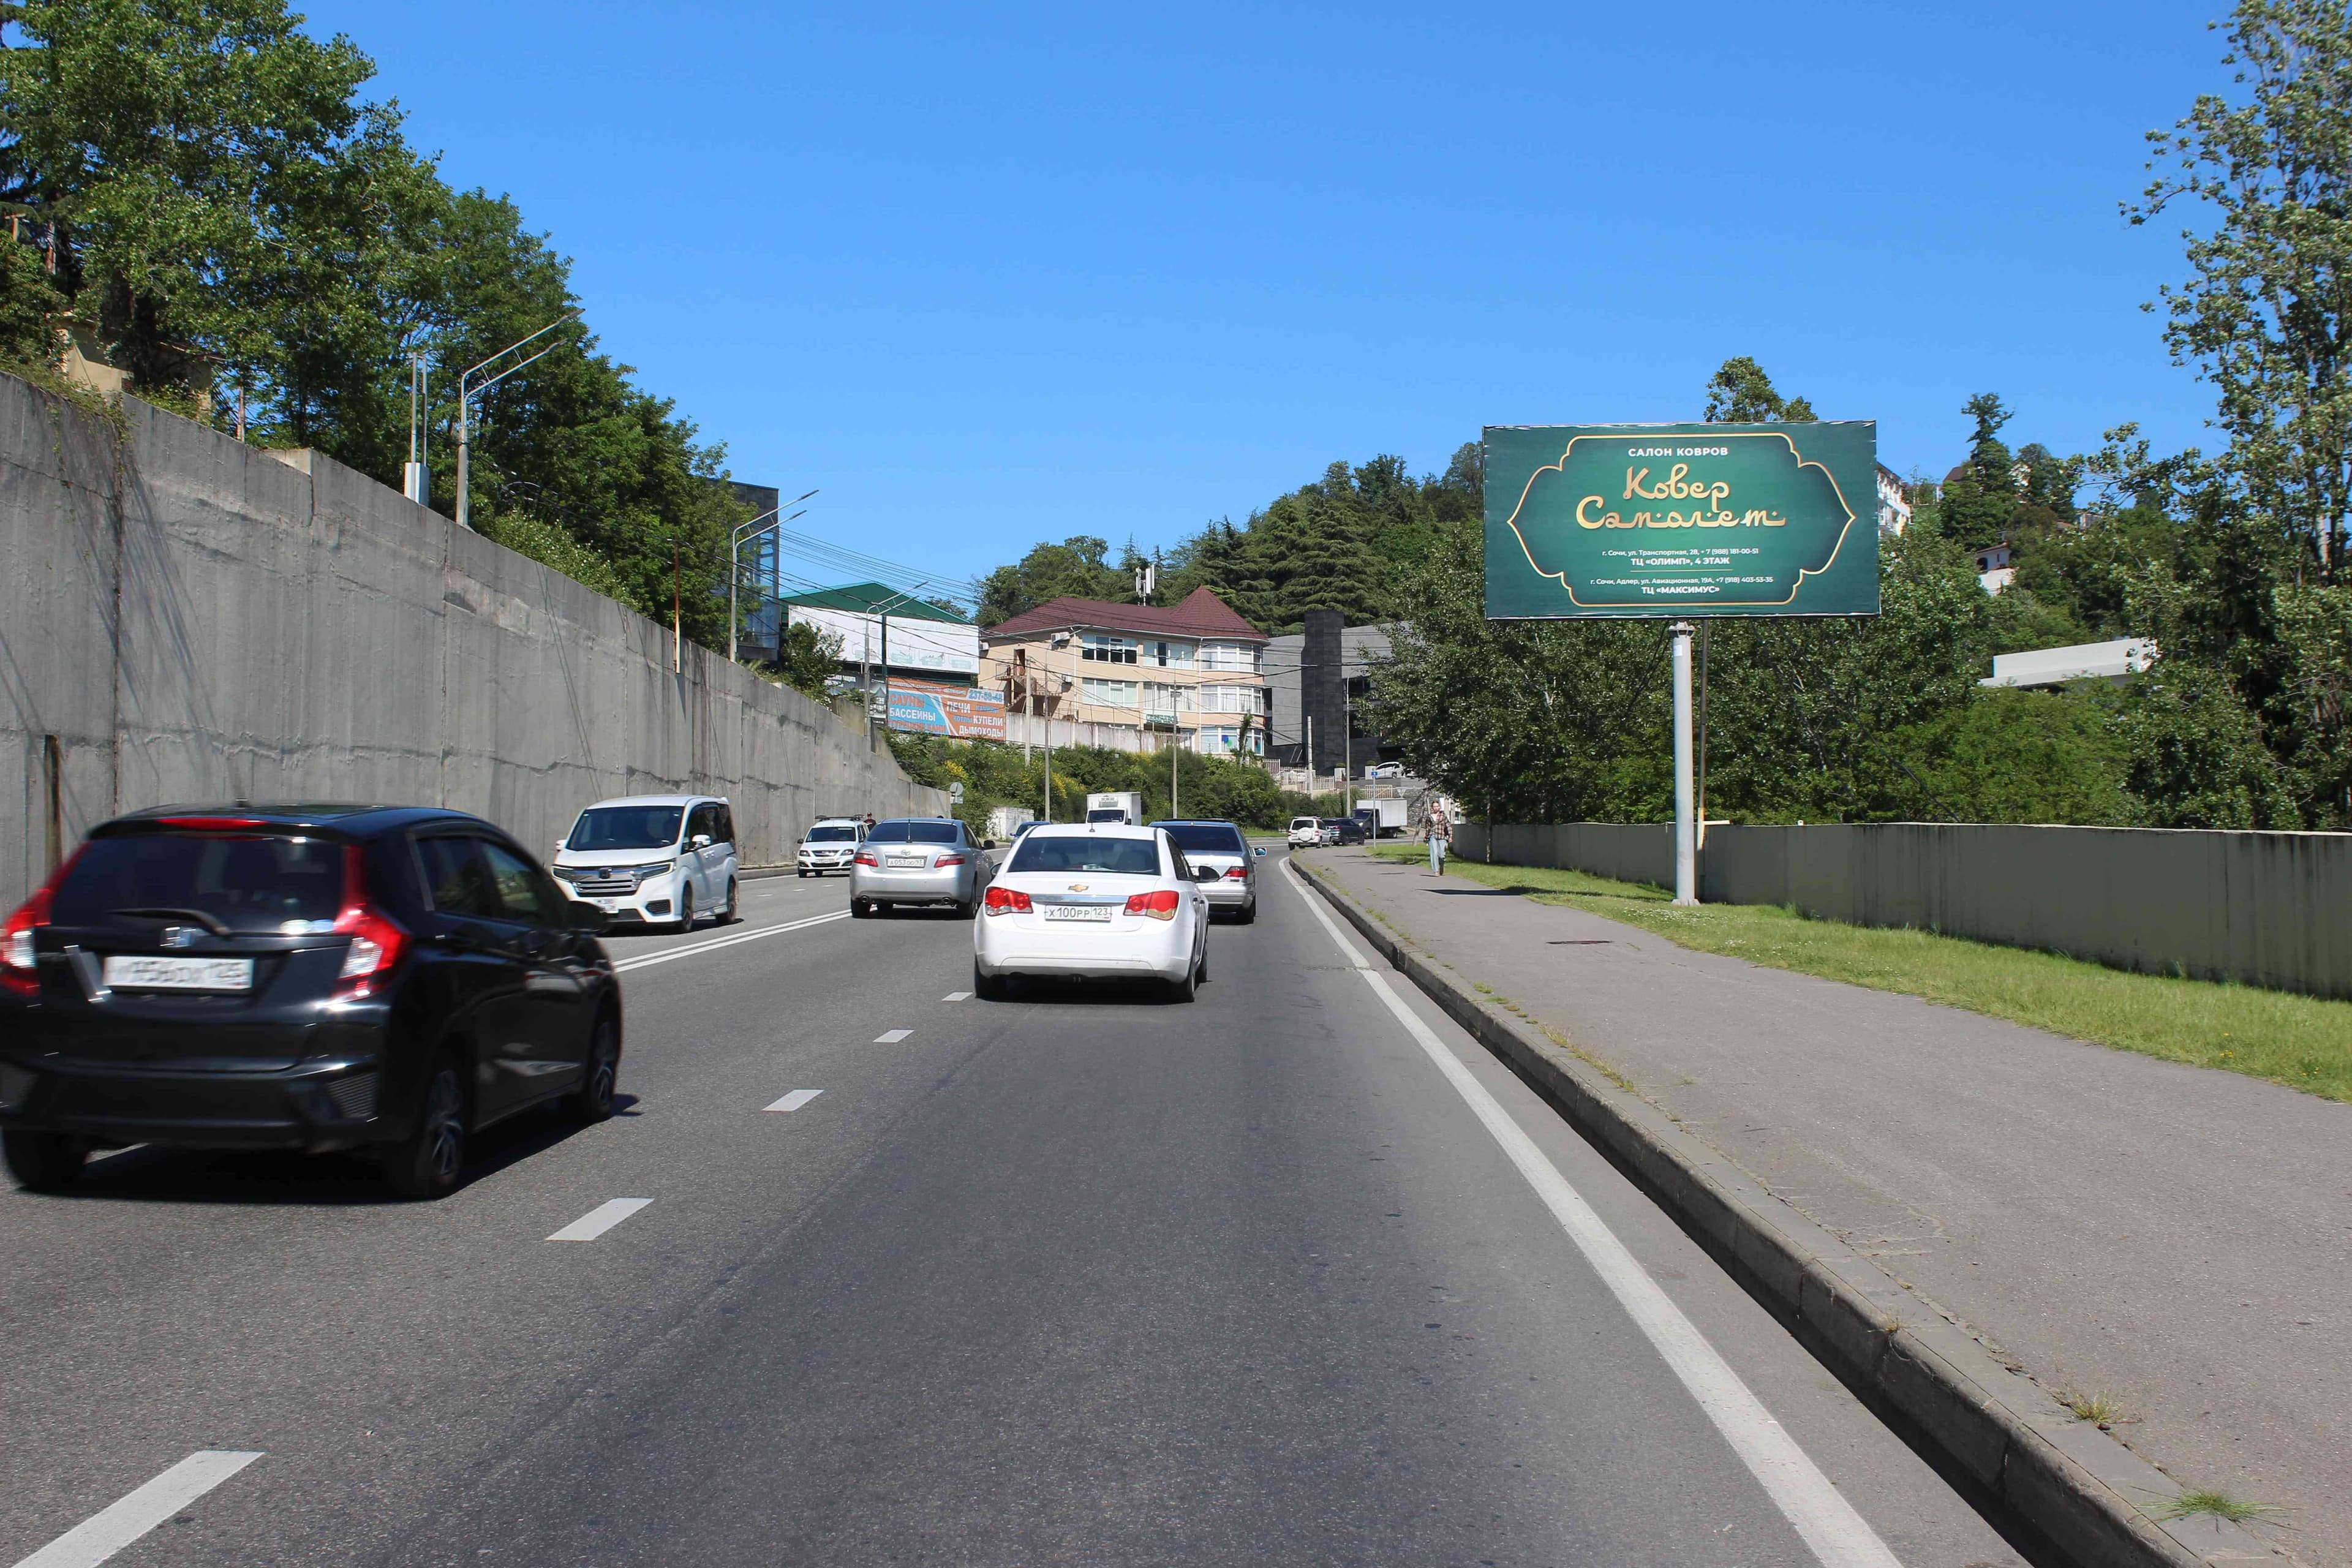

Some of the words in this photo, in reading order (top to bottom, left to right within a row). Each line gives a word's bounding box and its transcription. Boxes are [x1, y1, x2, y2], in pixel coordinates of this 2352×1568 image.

[1628, 448, 1672, 457] САЛОН
[1676, 447, 1728, 456] КОВРОВ
[1623, 463, 1730, 513] Ковер
[890, 694, 925, 709] САУНЫ
[947, 701, 971, 714] ПЕЧИ
[889, 707, 936, 722] БАССЕЙНЫ
[973, 715, 1003, 726] КУПЕЛИ
[959, 725, 1004, 737] ДЫМОХОДЫ
[1049, 907, 1090, 918] Х100РР
